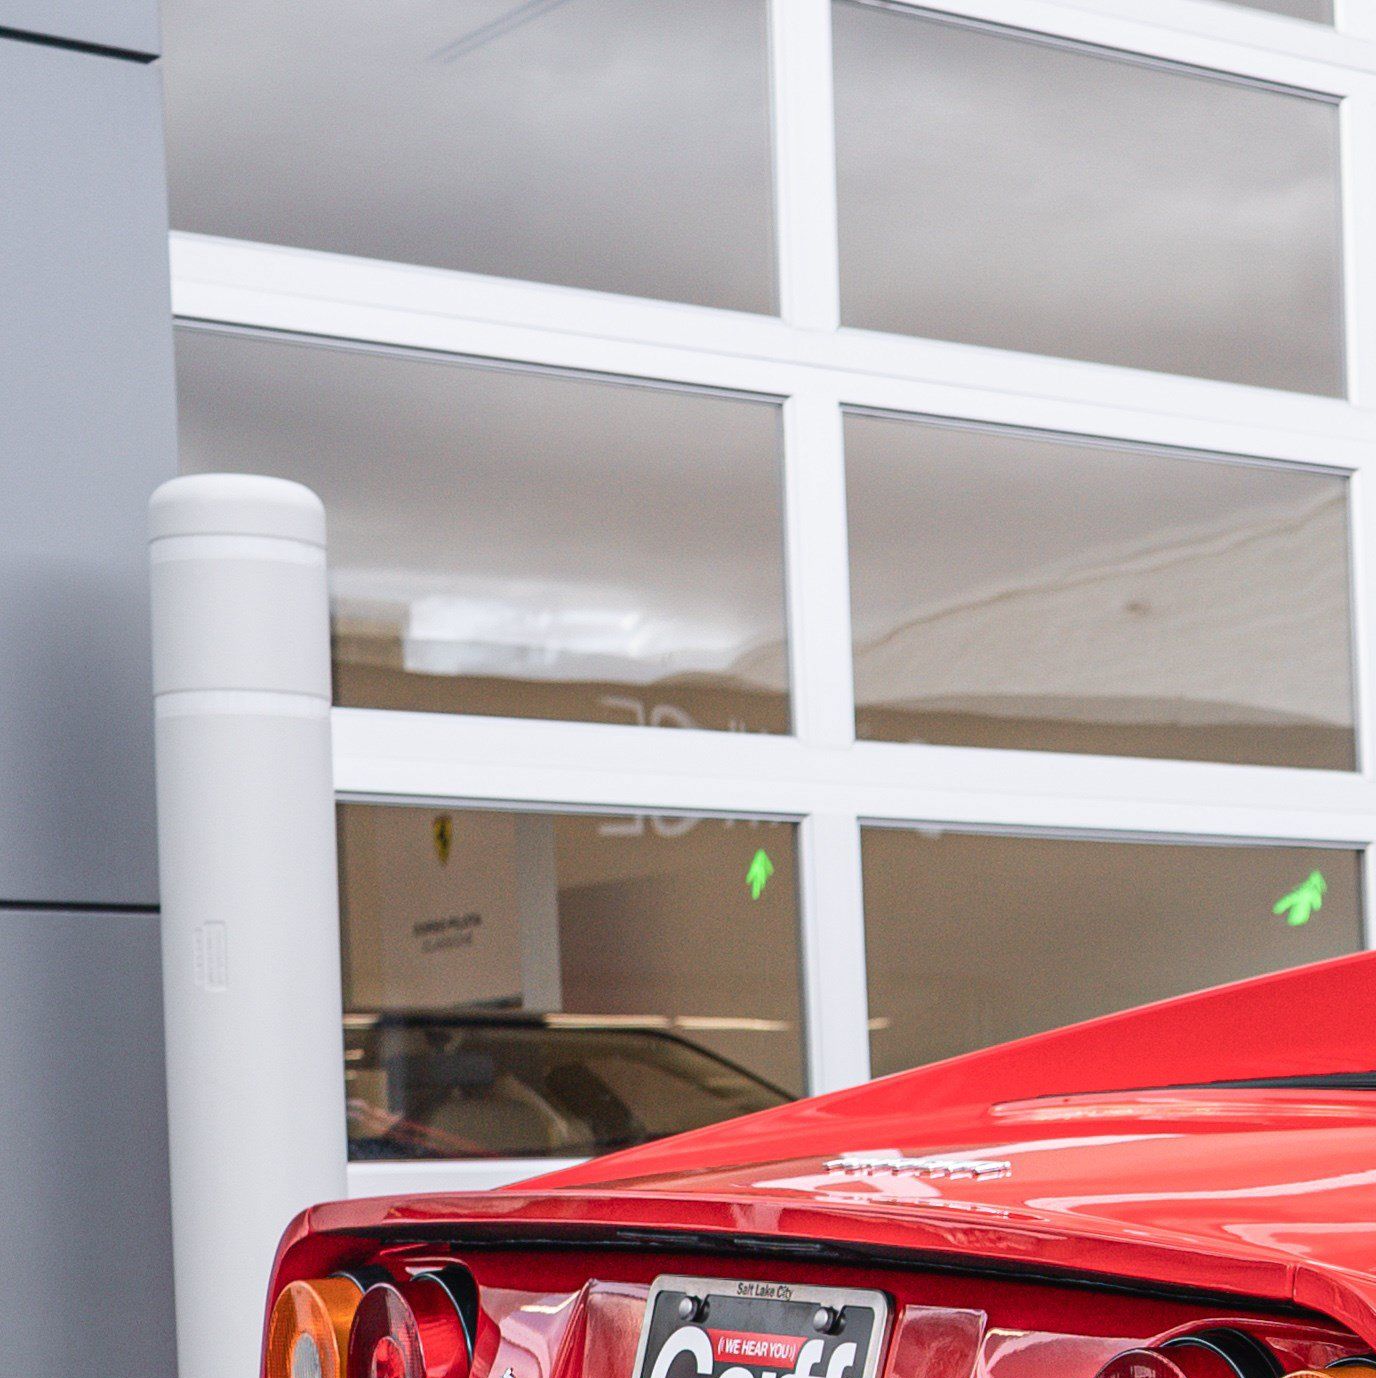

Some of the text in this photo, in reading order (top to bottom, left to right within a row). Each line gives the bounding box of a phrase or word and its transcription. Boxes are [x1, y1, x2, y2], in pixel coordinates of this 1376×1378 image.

[737, 1282, 792, 1301] Salt Lake City
[741, 1339, 769, 1357] HEAR
